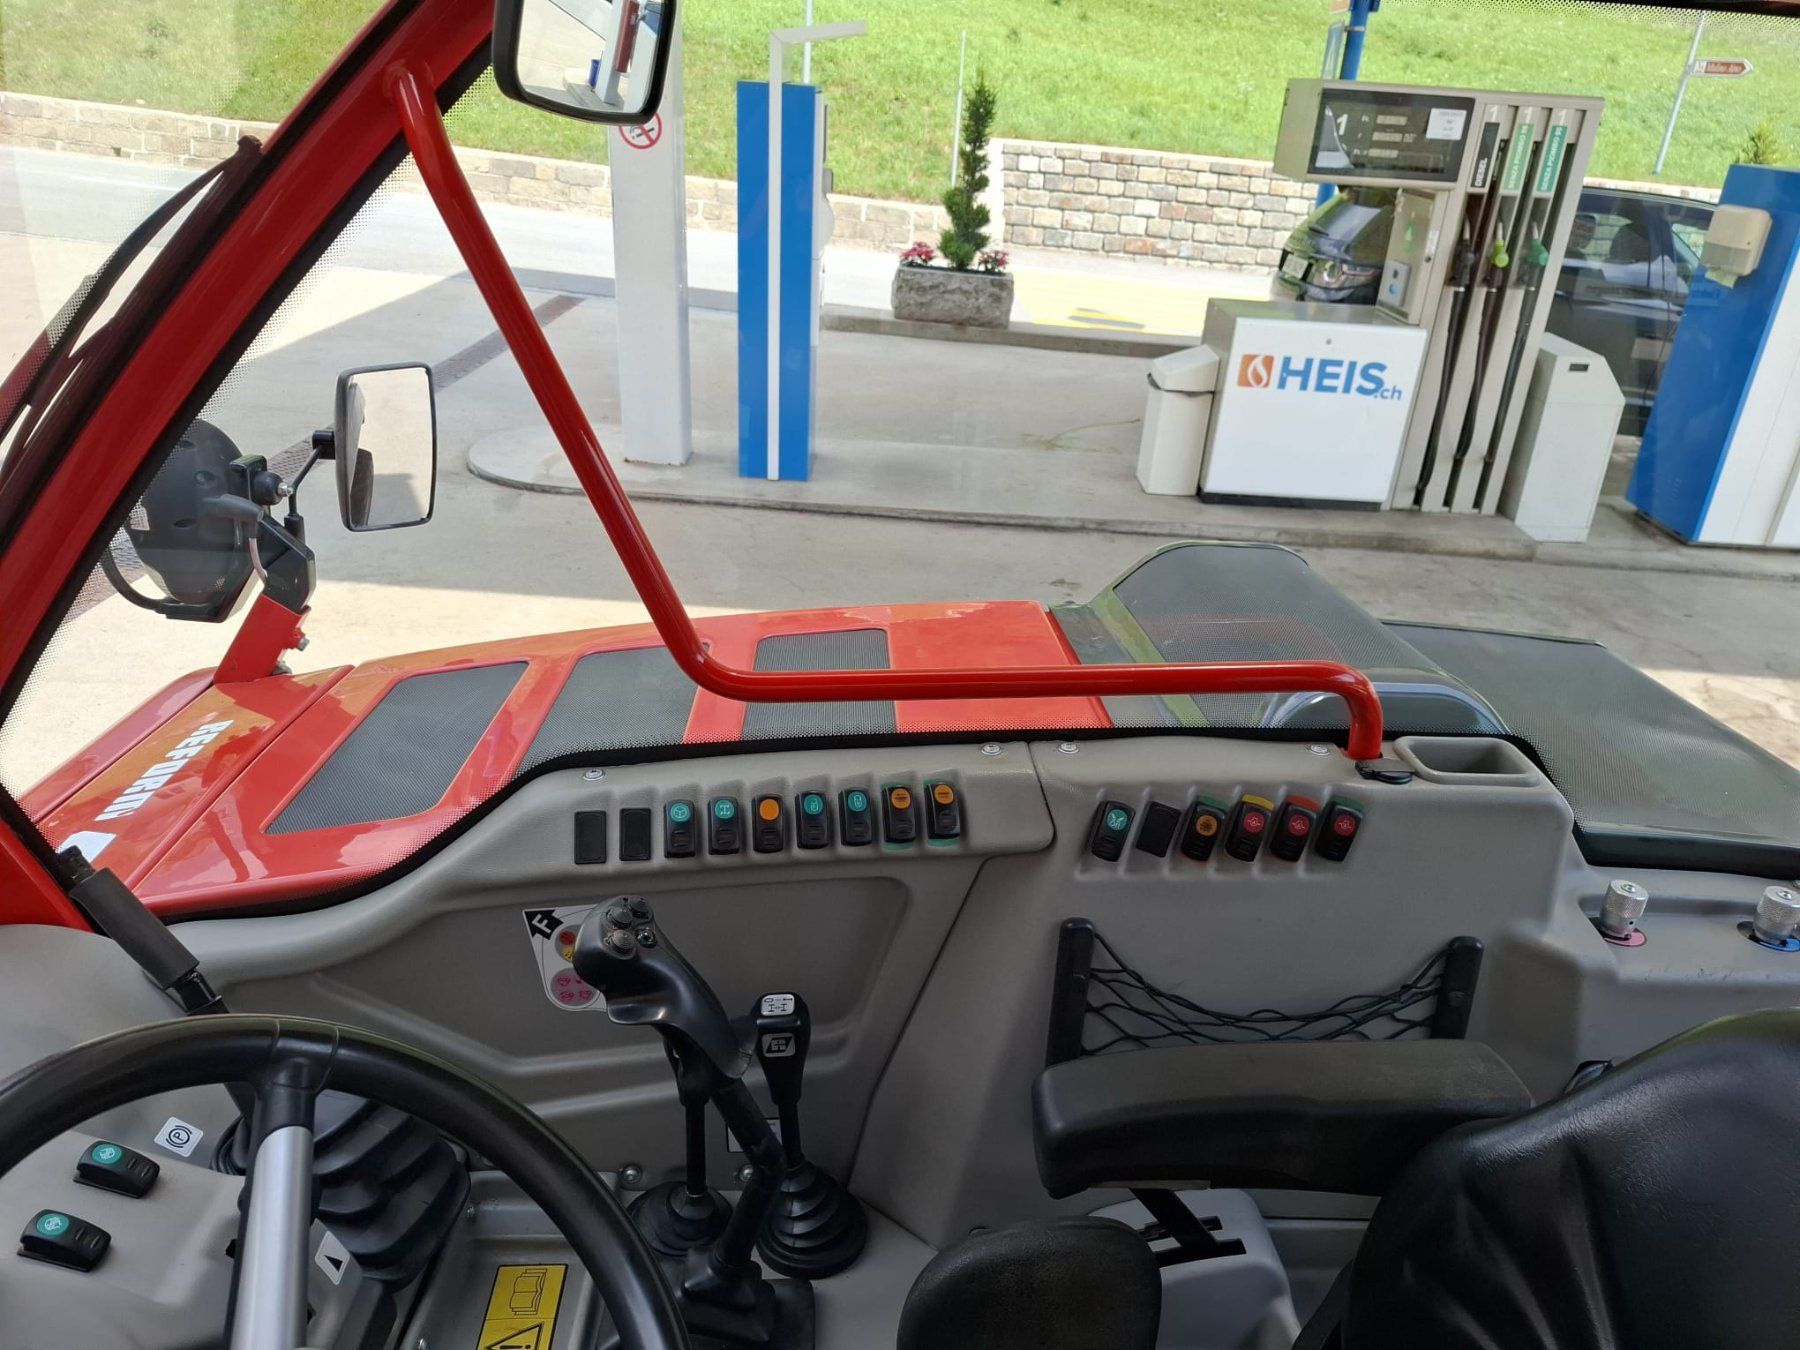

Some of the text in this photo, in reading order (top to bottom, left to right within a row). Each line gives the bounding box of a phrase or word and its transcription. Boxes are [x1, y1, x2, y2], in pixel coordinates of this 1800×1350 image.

[1336, 113, 1349, 136] 1
[1474, 157, 1488, 187] DIESEL
[94, 719, 235, 822] REFORM
[531, 913, 552, 934] F
[173, 1131, 184, 1142] P
